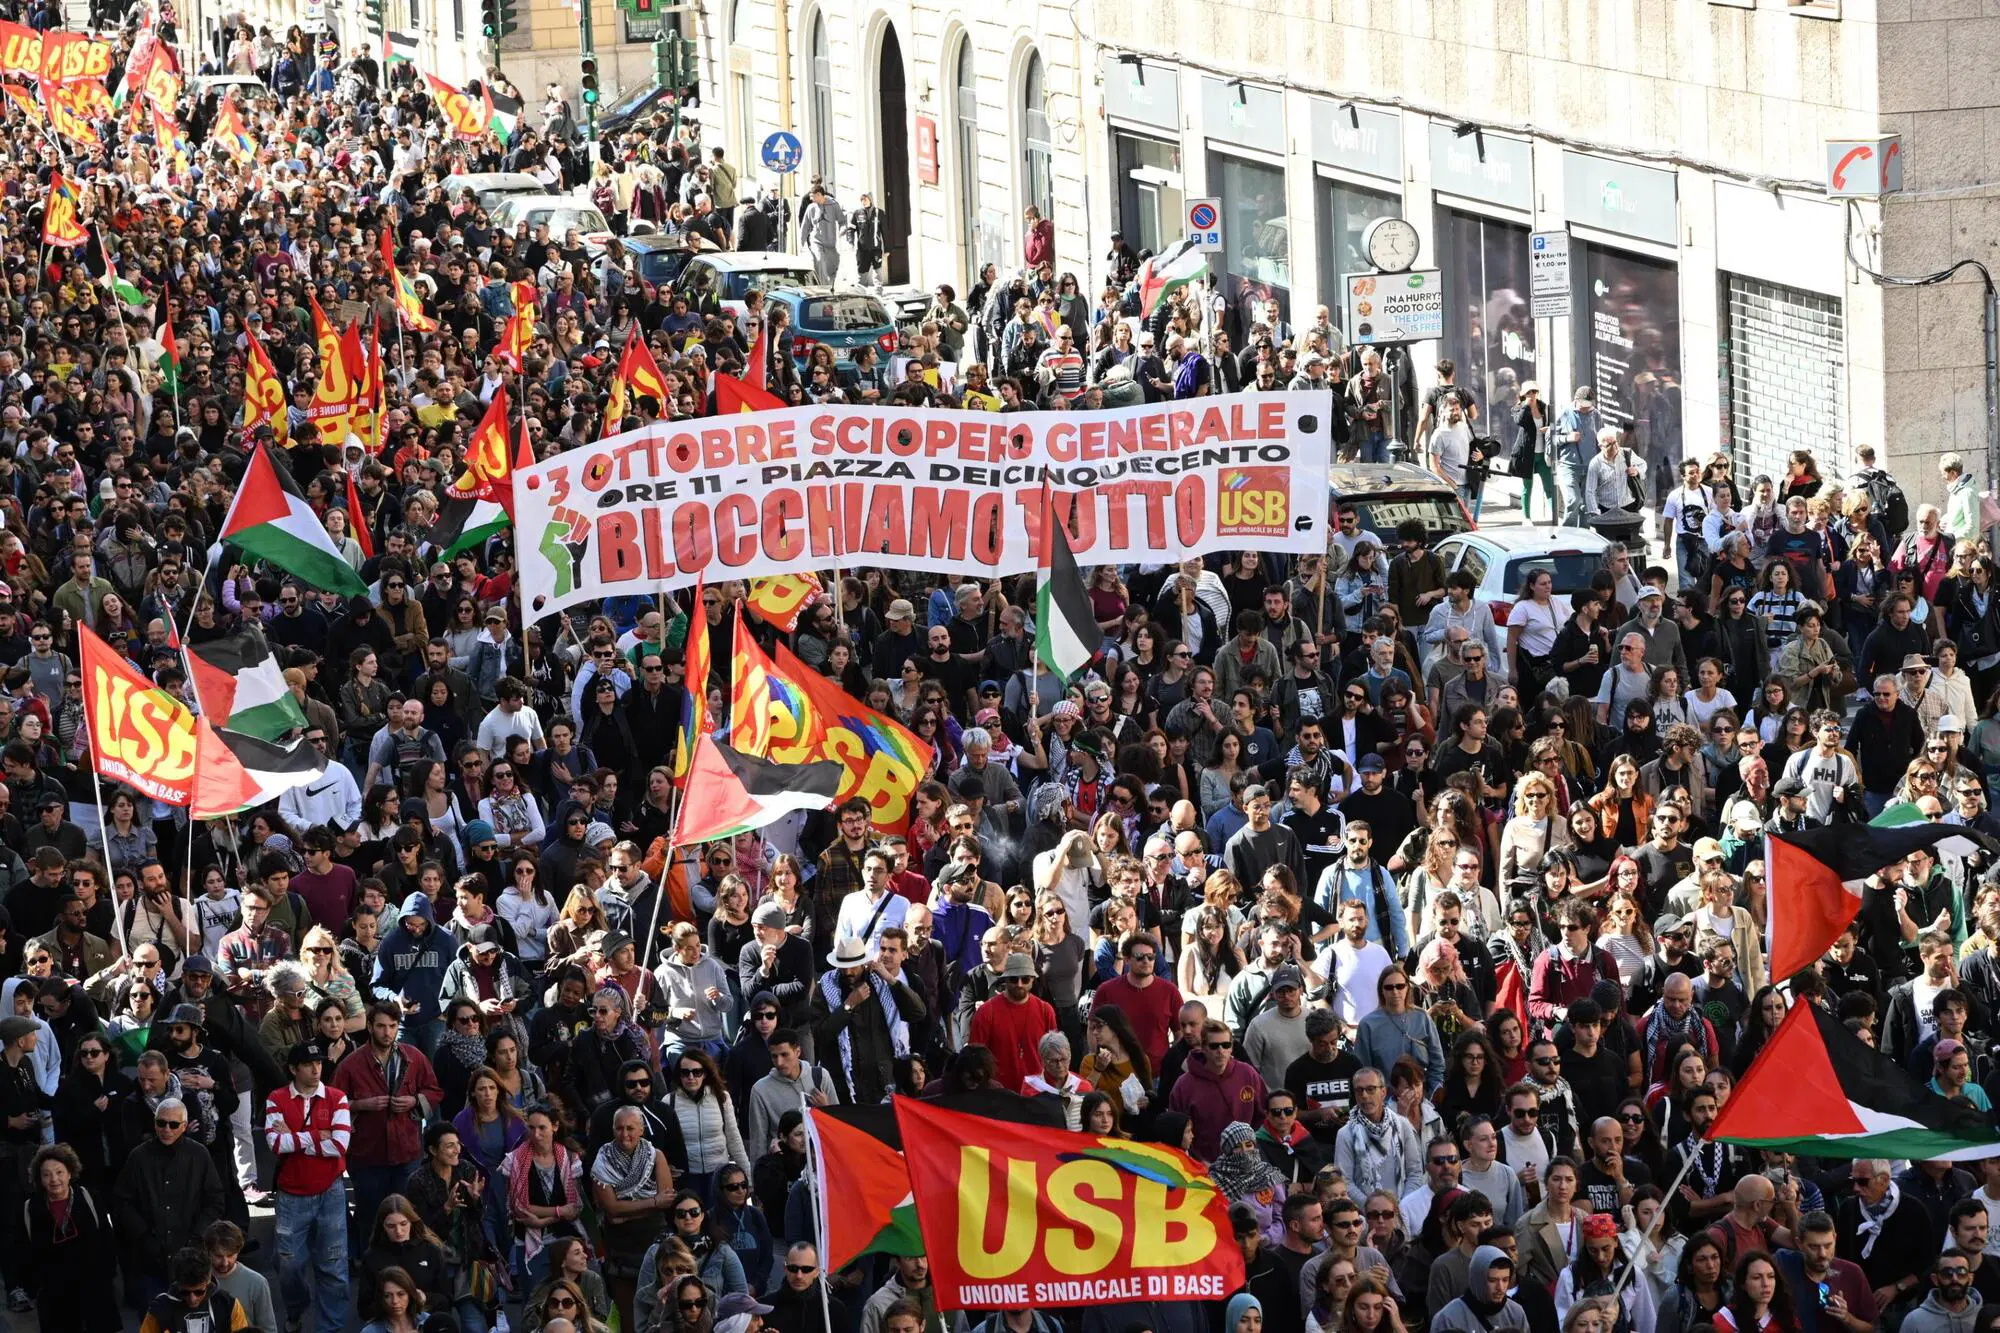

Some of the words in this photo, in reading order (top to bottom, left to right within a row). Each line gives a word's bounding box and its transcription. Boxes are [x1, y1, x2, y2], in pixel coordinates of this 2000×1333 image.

[4, 35, 43, 71] US
[1383, 303, 1411, 314] FOOD
[1411, 303, 1424, 312] TO
[1425, 302, 1441, 311] GO!
[1386, 295, 1397, 304] IN
[1398, 294, 1405, 303] A
[1406, 291, 1442, 303] HURRY?
[1394, 314, 1411, 323] THE
[1412, 312, 1441, 322] DRINK
[1420, 322, 1441, 331] FREE
[547, 465, 571, 506] 3
[581, 419, 798, 492] OTTOBRE
[809, 414, 1034, 463] SCIOPERO
[1045, 402, 1286, 463] GENERALE
[597, 481, 678, 508] ORE
[689, 474, 722, 495] 11
[761, 458, 915, 484] PIAZZA
[929, 463, 1000, 487] DEI
[1003, 444, 1291, 488] CINQUECENTO
[1220, 490, 1287, 527] USB
[596, 482, 1004, 585] BLOCCHIAMO
[1015, 474, 1206, 558] TUTTO
[95, 665, 198, 781] USB
[822, 726, 916, 824] SB
[1813, 767, 1836, 782] HH
[1306, 1080, 1350, 1096] FREE
[957, 1145, 1218, 1279] USB
[958, 1284, 1030, 1305] UNIONE
[1035, 1277, 1141, 1303] SINDACALE
[1148, 1275, 1168, 1296] DI
[1173, 1275, 1224, 1296] BASE
